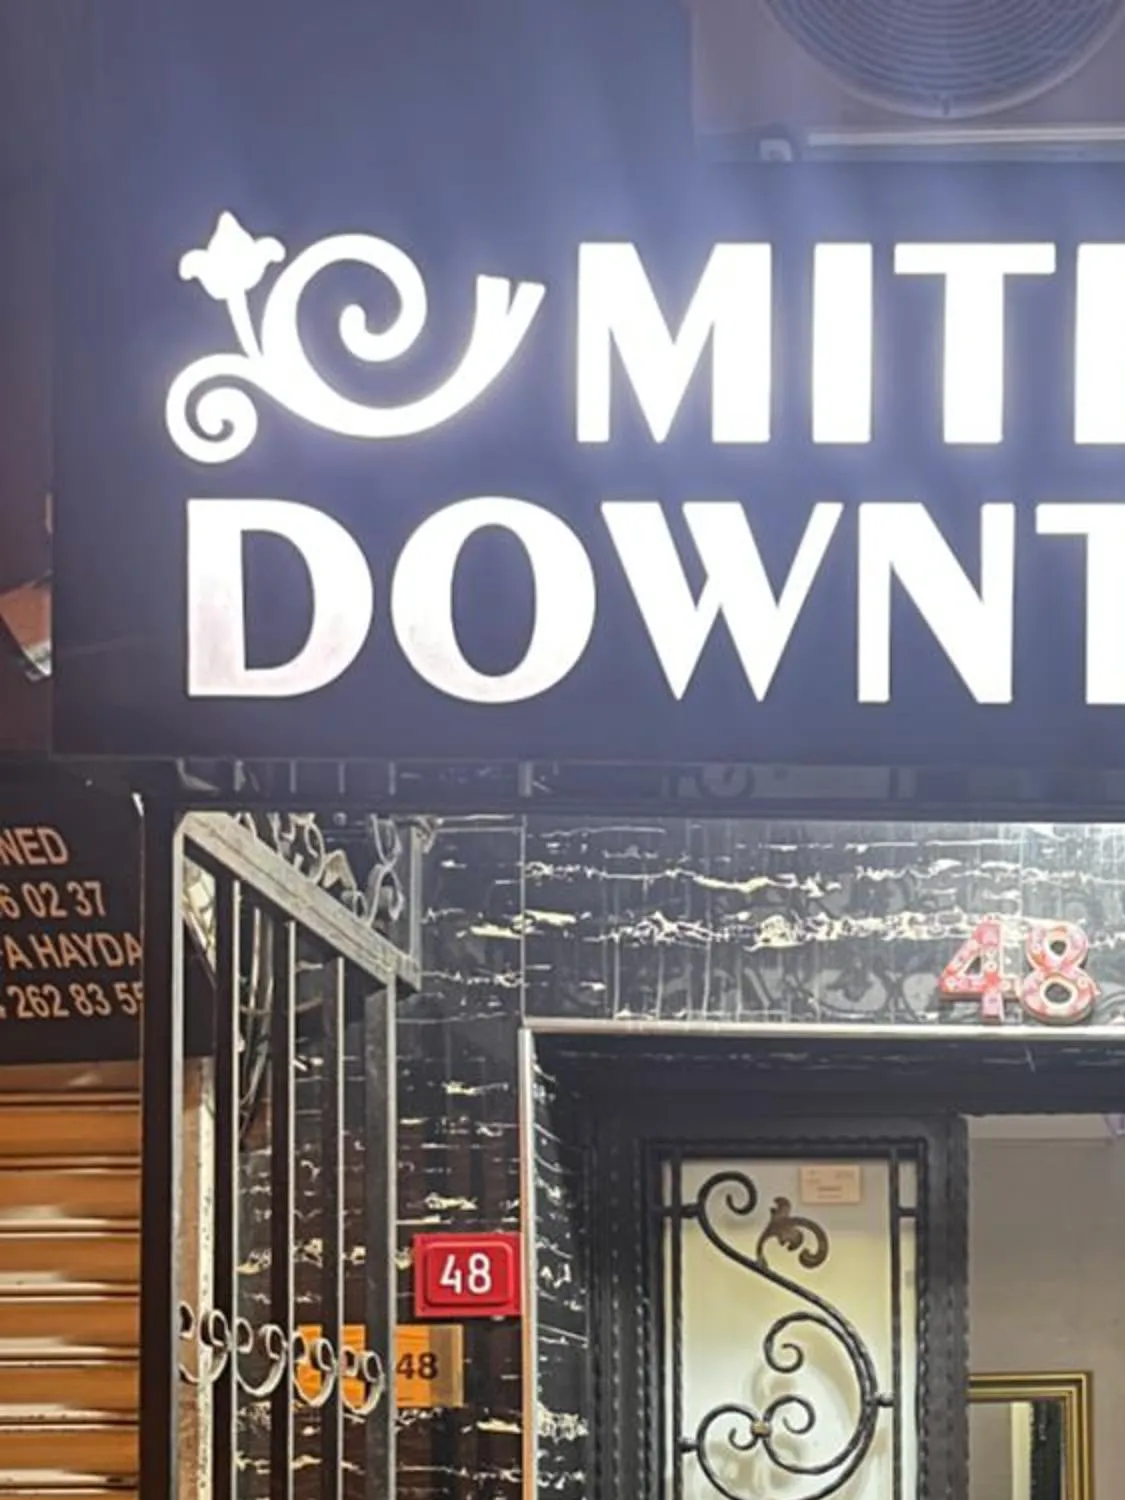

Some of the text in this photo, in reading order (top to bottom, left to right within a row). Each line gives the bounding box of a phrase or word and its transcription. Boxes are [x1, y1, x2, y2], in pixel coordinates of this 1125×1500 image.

[21, 881, 68, 919] 02
[67, 880, 107, 918] 37
[0, 934, 34, 970] A
[938, 913, 1100, 1025] 48
[6, 984, 70, 1019] 262
[68, 982, 112, 1016] 83
[439, 1252, 493, 1295] 48
[397, 1352, 439, 1380] 48
